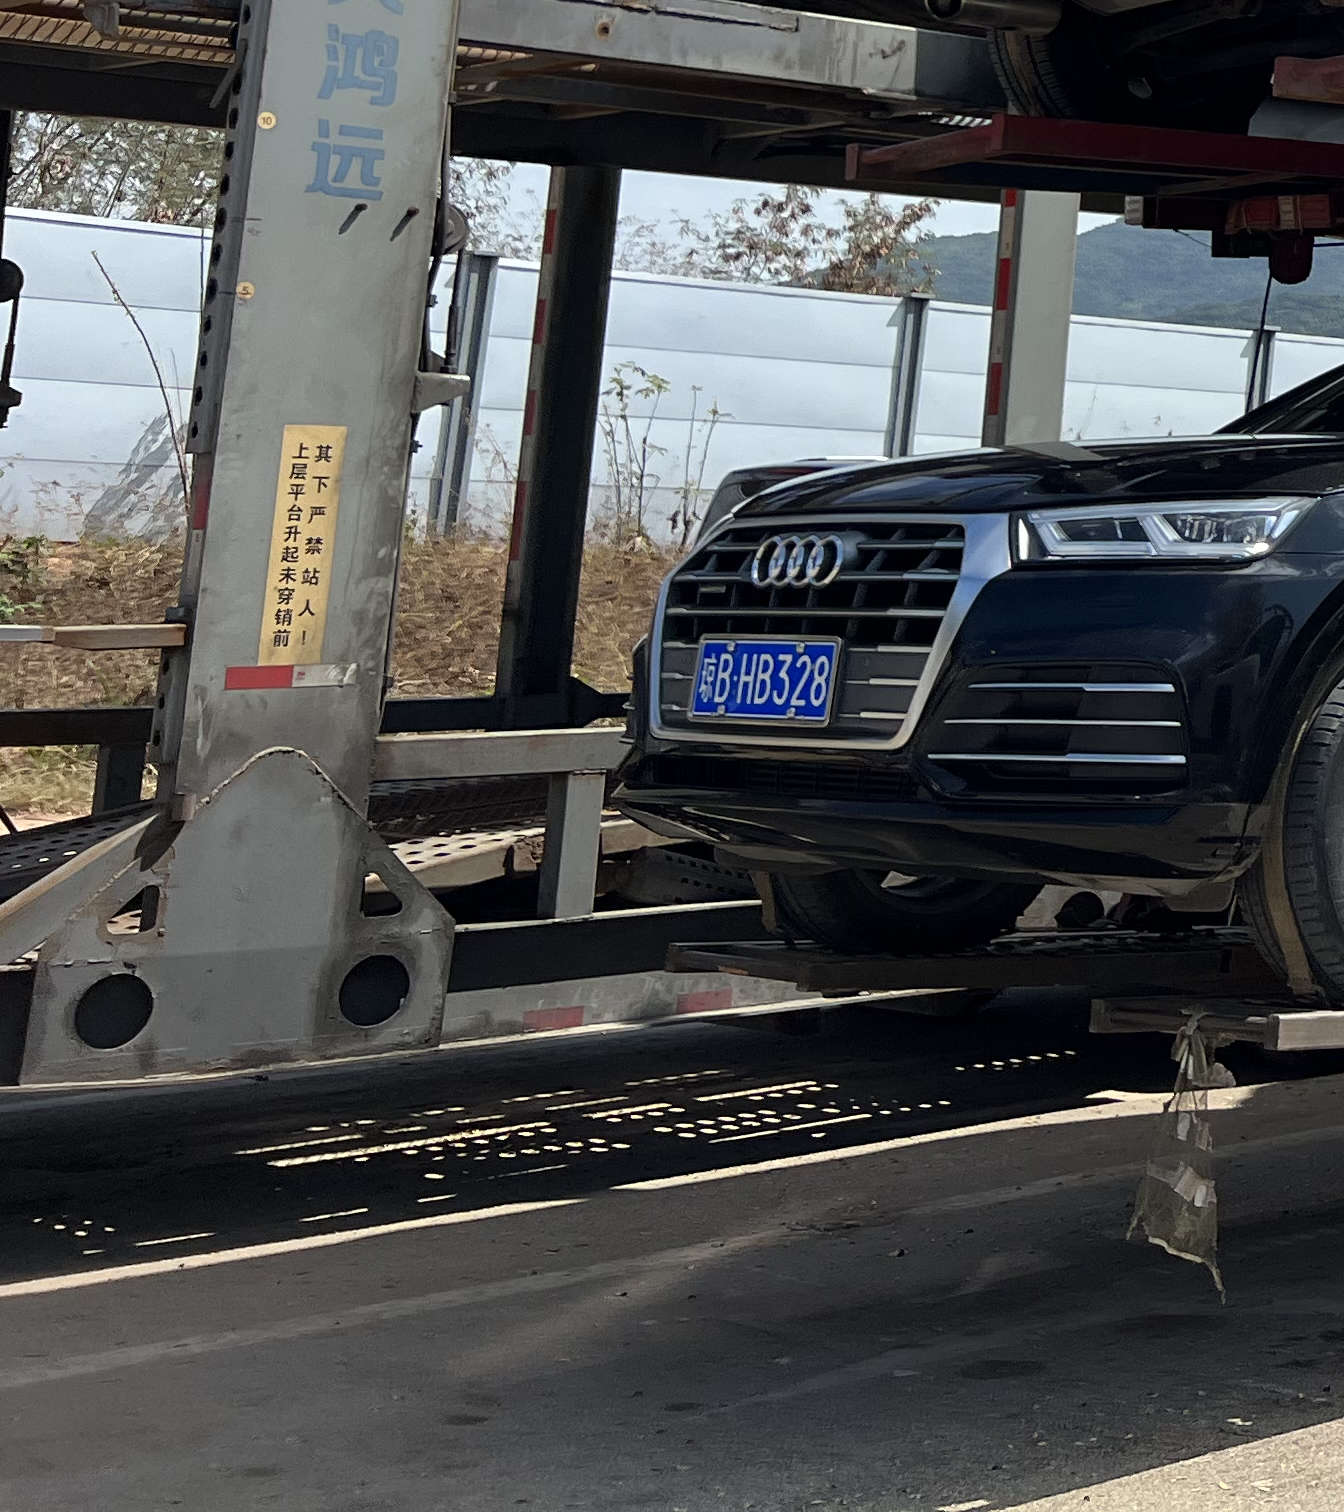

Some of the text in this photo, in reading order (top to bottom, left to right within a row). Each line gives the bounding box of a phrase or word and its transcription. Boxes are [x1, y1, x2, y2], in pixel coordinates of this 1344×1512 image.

[272, 442, 310, 648] 上层平台升起未穿销前
